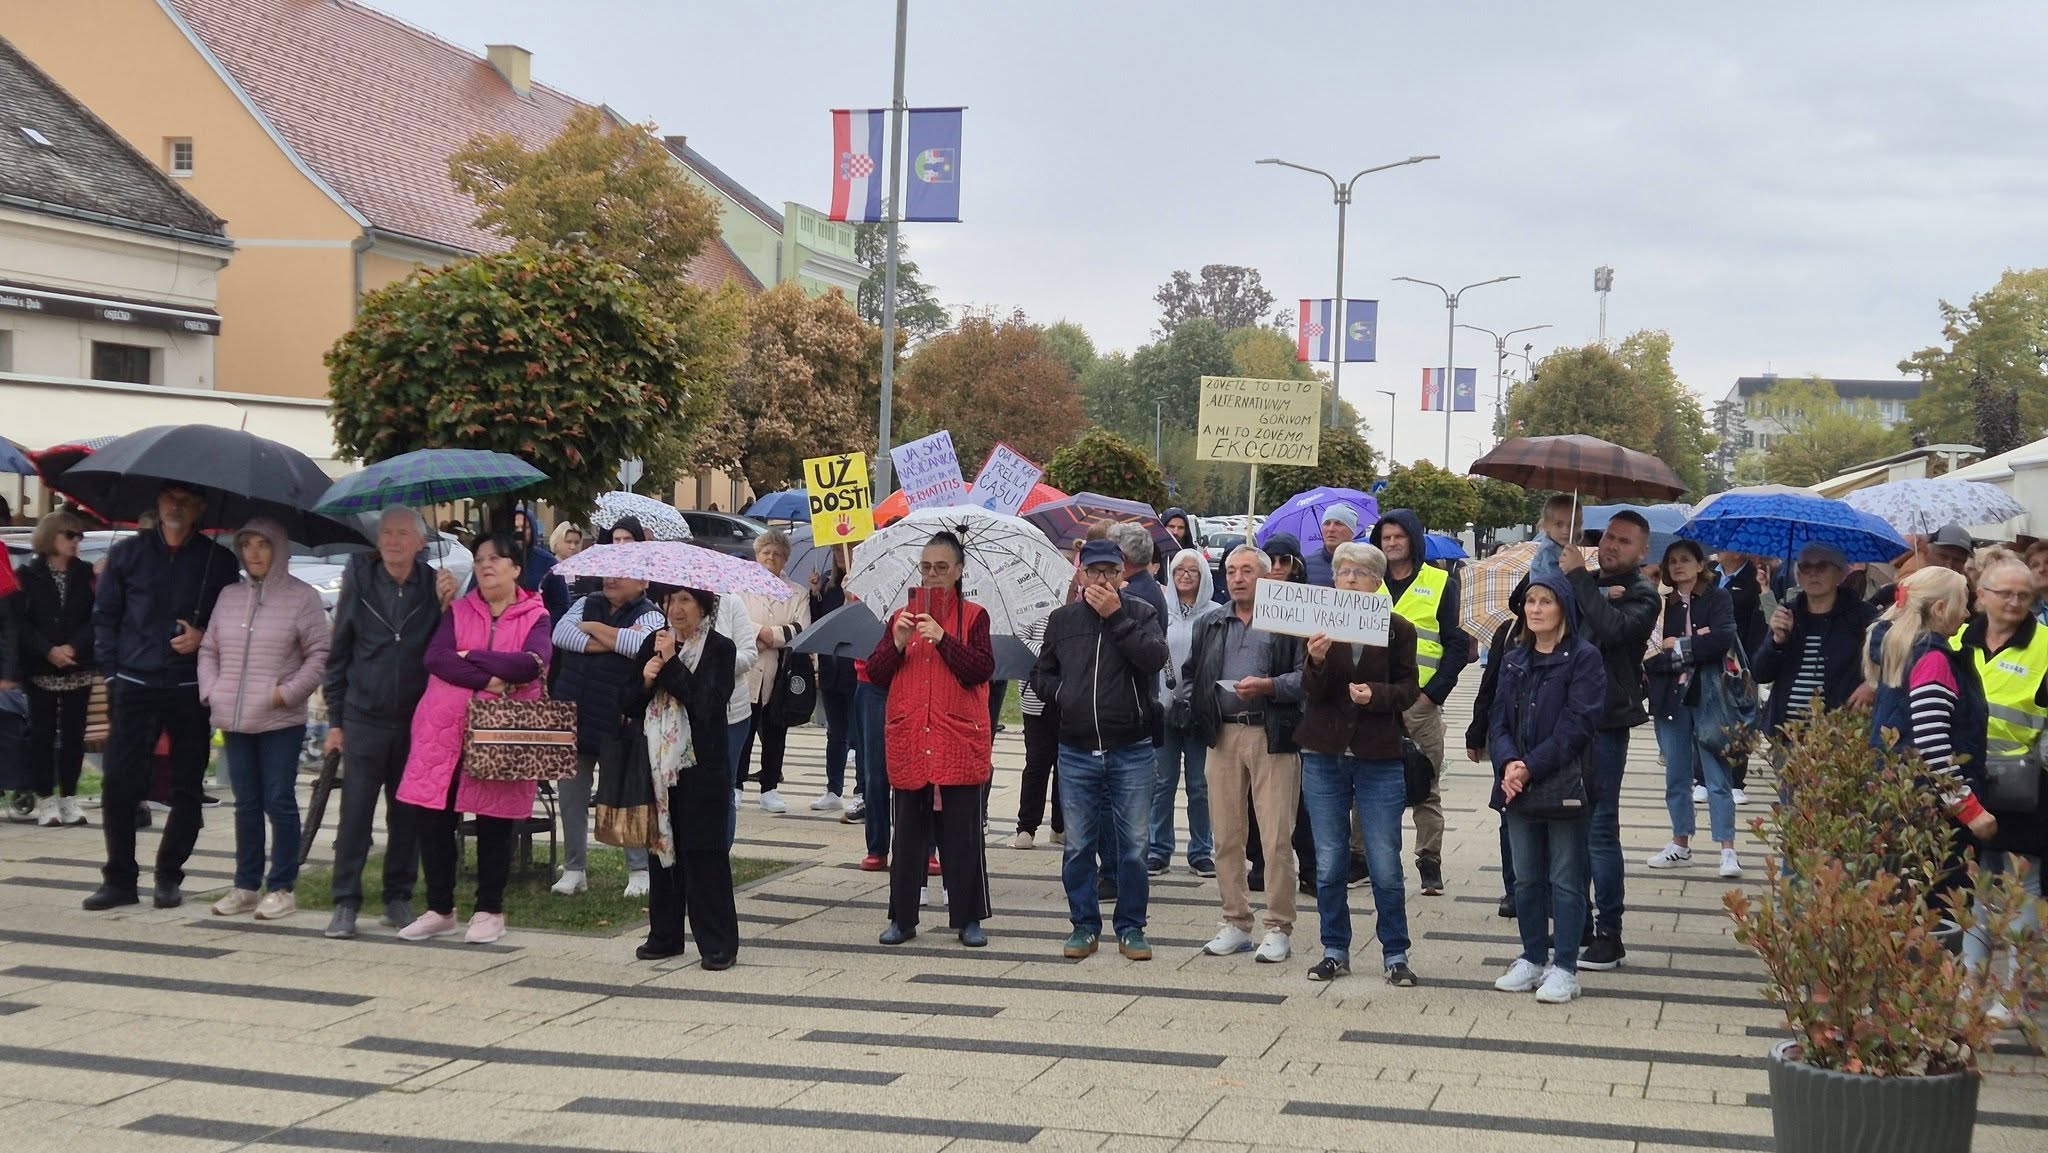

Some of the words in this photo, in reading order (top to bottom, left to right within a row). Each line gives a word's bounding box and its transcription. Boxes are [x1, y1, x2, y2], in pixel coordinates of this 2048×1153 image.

[1206, 379, 1246, 391] ZOVETE
[1255, 381, 1269, 392] TO
[1276, 382, 1290, 392] TO
[1296, 382, 1312, 393] TO
[1202, 424, 1211, 435] A
[1215, 426, 1230, 436] MI
[1235, 426, 1250, 437] TO
[1254, 428, 1304, 441] ZOVEMO
[903, 447, 920, 463] JA
[922, 434, 952, 456] SAM
[997, 447, 1013, 462] OVA
[1010, 459, 1020, 469] JE
[1021, 464, 1038, 478] KAP
[1210, 438, 1313, 460] EKOCIDOM
[814, 454, 858, 489] UŽ
[991, 460, 1028, 493] PRELILA
[905, 477, 960, 506] DERMATITIS
[980, 471, 1024, 511] ČAŠU!
[1268, 583, 1329, 606] IZDAJICE
[1333, 590, 1390, 614] NARODA
[1255, 603, 1305, 623] PRODALI
[1313, 607, 1350, 629] VRAGU
